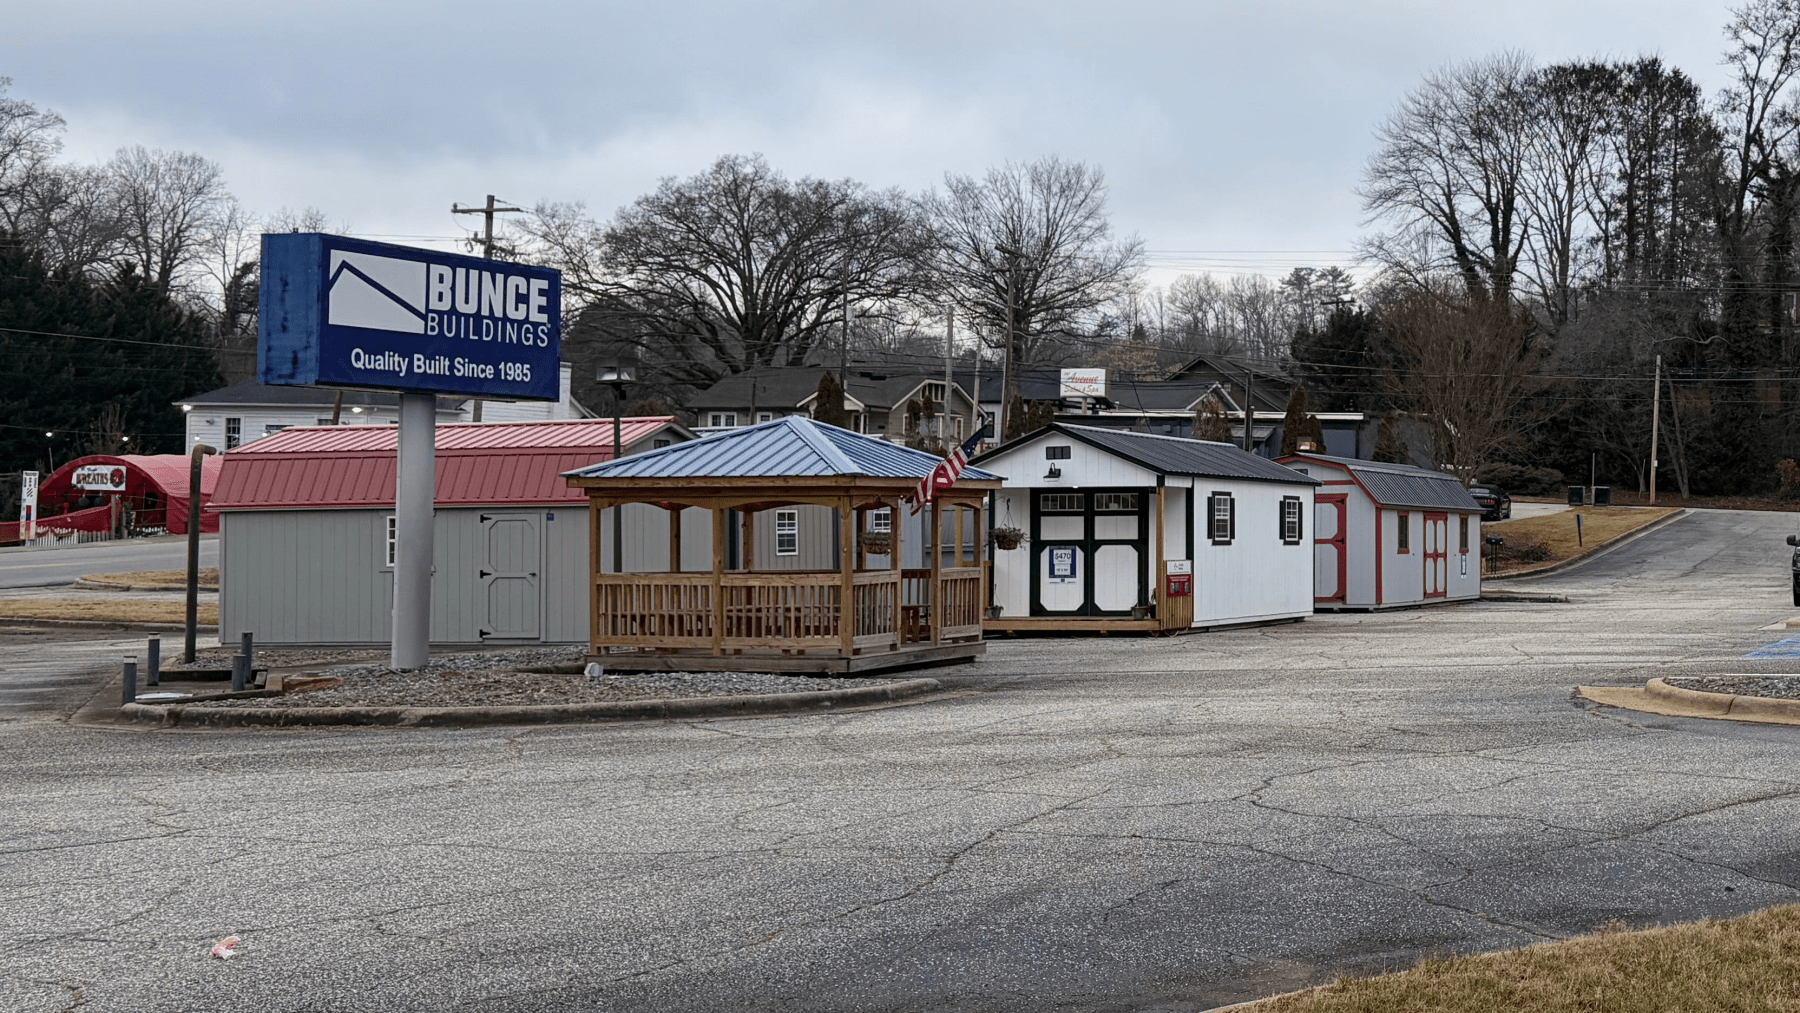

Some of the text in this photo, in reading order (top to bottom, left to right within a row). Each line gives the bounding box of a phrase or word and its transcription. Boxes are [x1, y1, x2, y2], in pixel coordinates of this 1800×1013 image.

[428, 263, 549, 323] BUNCE
[427, 313, 548, 347] BUILDINGS
[351, 348, 531, 382] Quality Built Since 1985
[1055, 552, 1071, 560] $470
